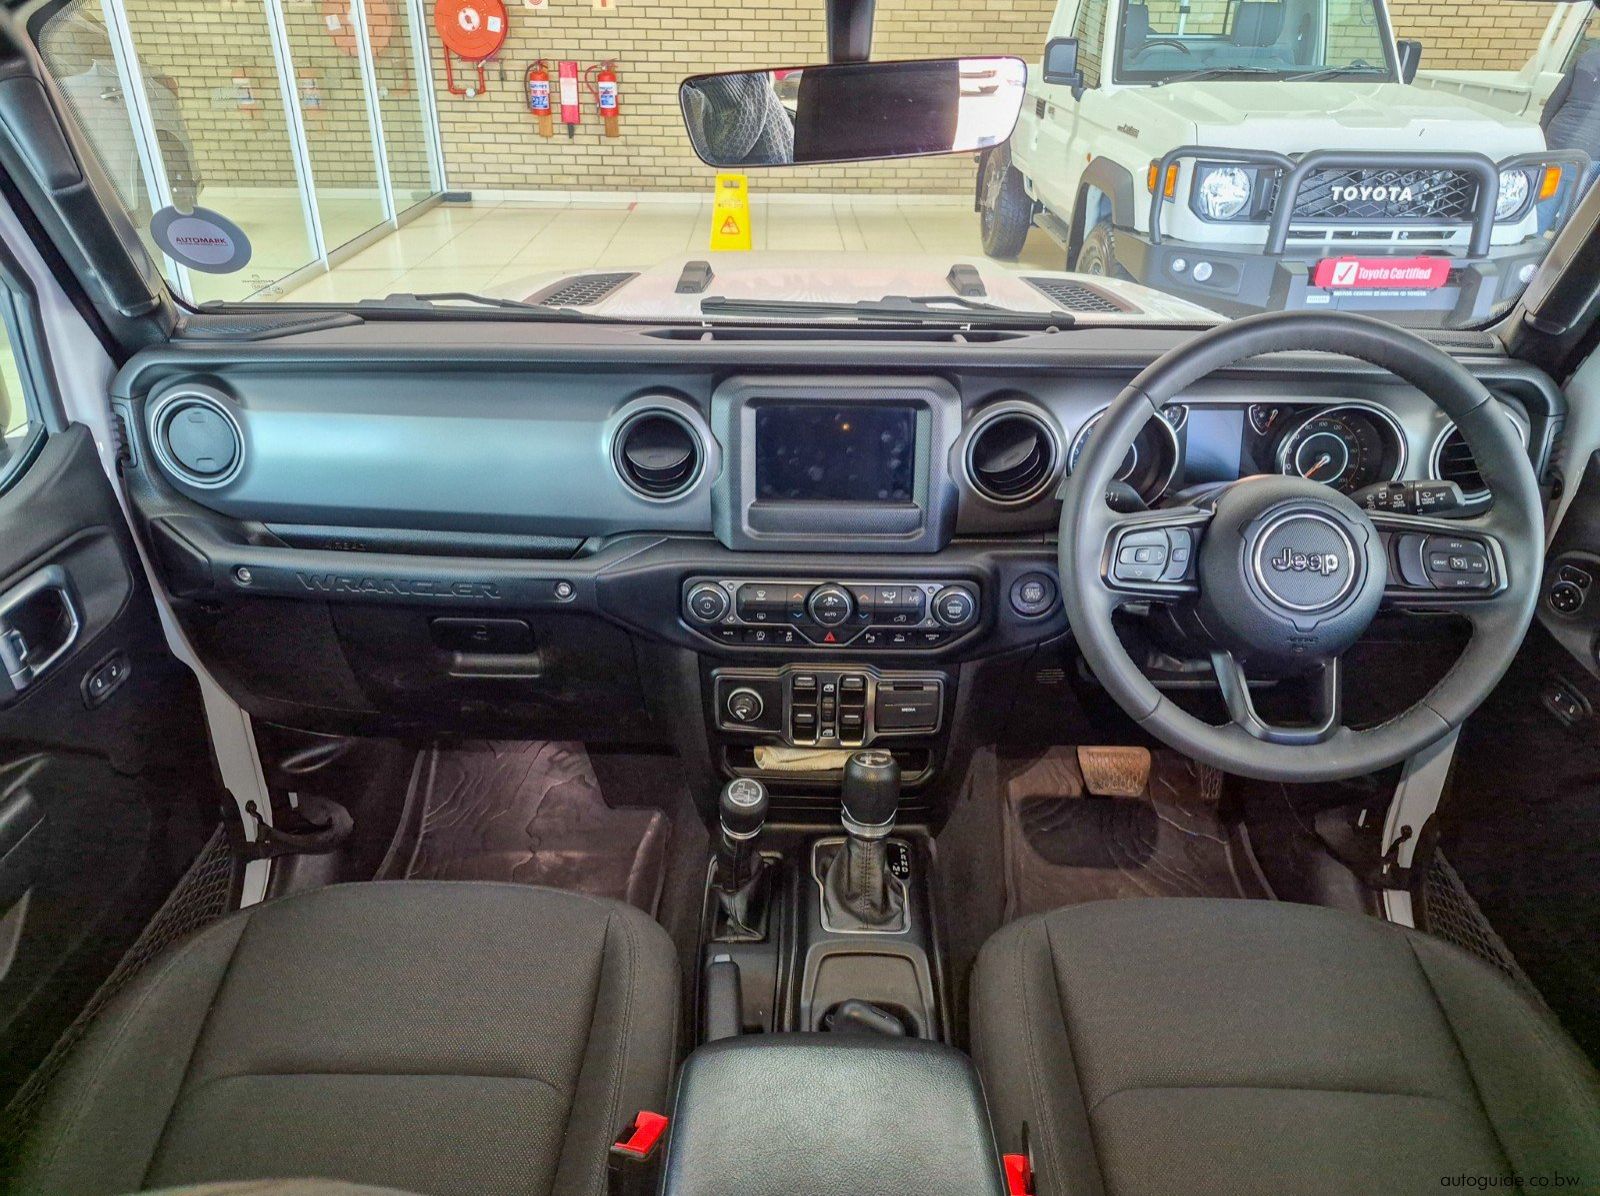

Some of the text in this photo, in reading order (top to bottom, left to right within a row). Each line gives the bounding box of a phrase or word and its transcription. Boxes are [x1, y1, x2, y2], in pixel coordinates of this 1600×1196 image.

[1331, 186, 1412, 201] TOYOTA
[176, 236, 227, 245] AUTOMARK
[1358, 267, 1433, 280] Toyota Certified
[1271, 547, 1339, 577] Jeep
[296, 572, 501, 599] WRANGLER
